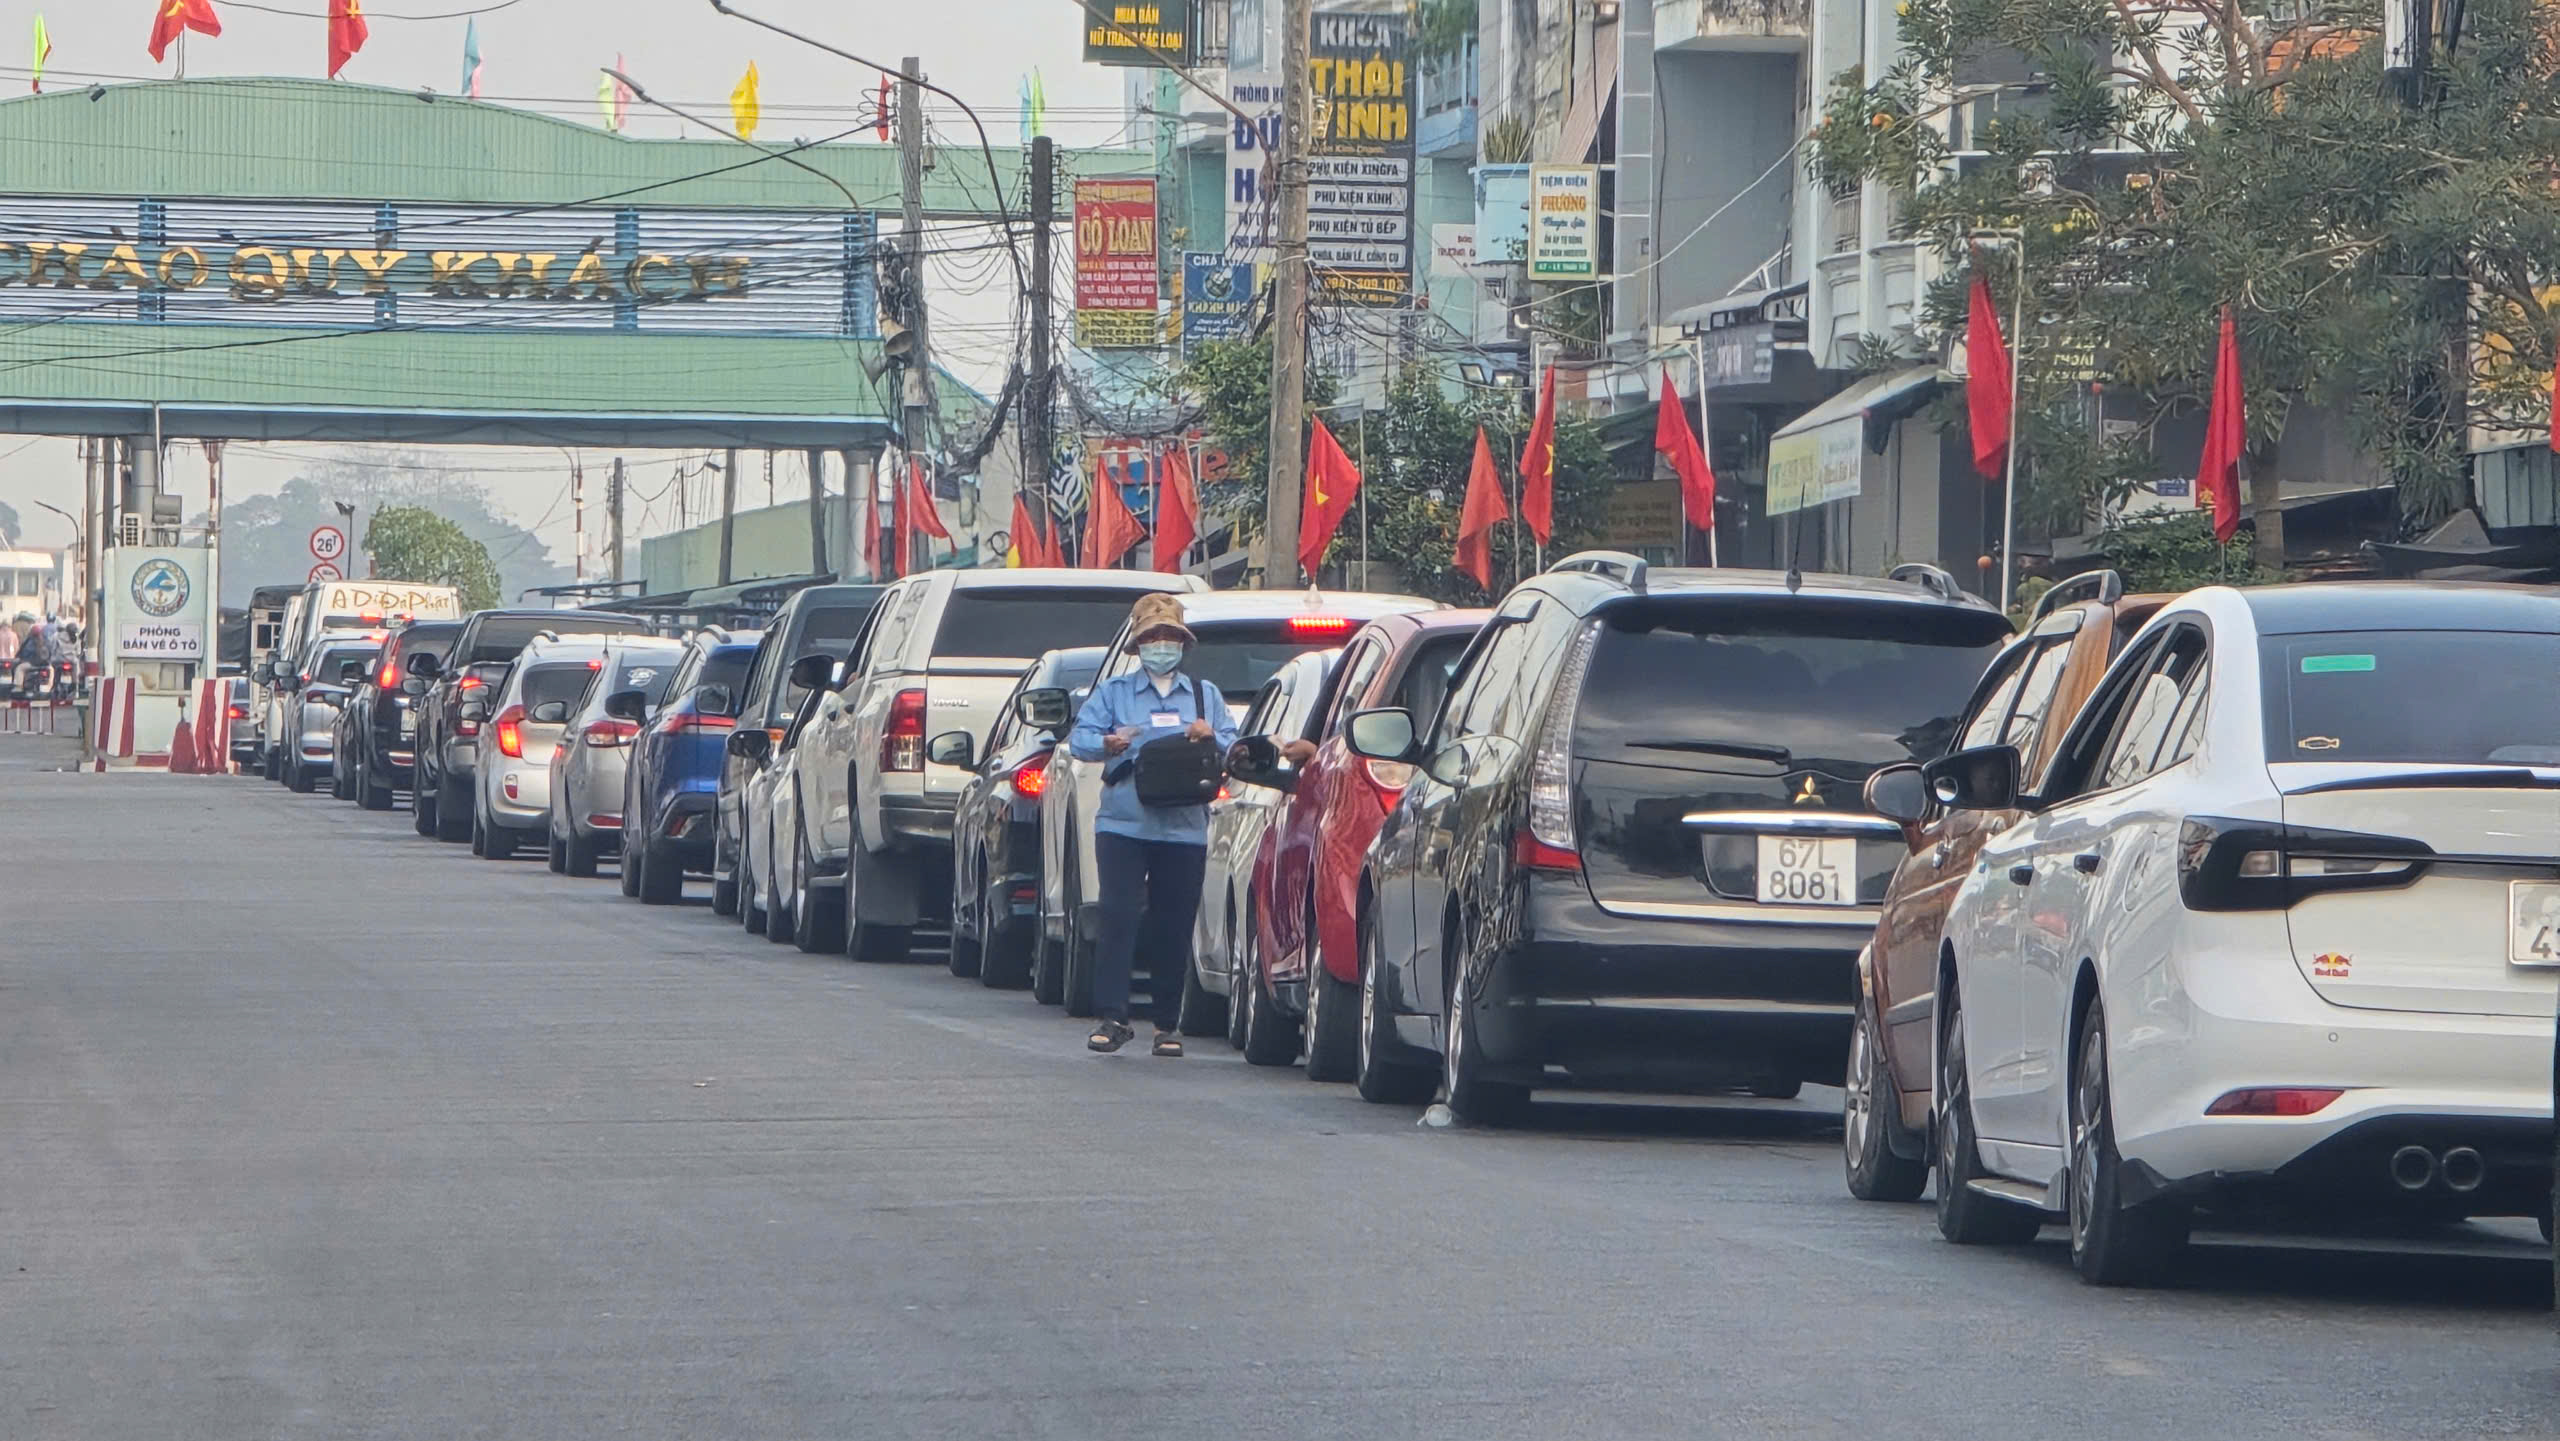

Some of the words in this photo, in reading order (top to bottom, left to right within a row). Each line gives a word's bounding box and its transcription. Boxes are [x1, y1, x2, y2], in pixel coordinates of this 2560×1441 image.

[1310, 51, 1404, 97] THÁI
[1233, 82, 1269, 102] PHÒNG
[1333, 160, 1358, 177] KIỆN
[1361, 162, 1399, 176] XINGFA
[1315, 191, 1336, 206] PHỤ
[1339, 190, 1363, 206] KIỆN
[1367, 189, 1392, 205] KÍNH
[1106, 216, 1154, 256] LOAN
[1309, 220, 1330, 235] PHỤ
[1333, 219, 1357, 235] KIỆN
[332, 588, 347, 609] A
[140, 625, 181, 637] PHÒNG
[123, 638, 147, 650] BÁN
[180, 638, 198, 651] TÔ
[1779, 839, 1836, 870] 67L
[1769, 870, 1840, 901] 8081
